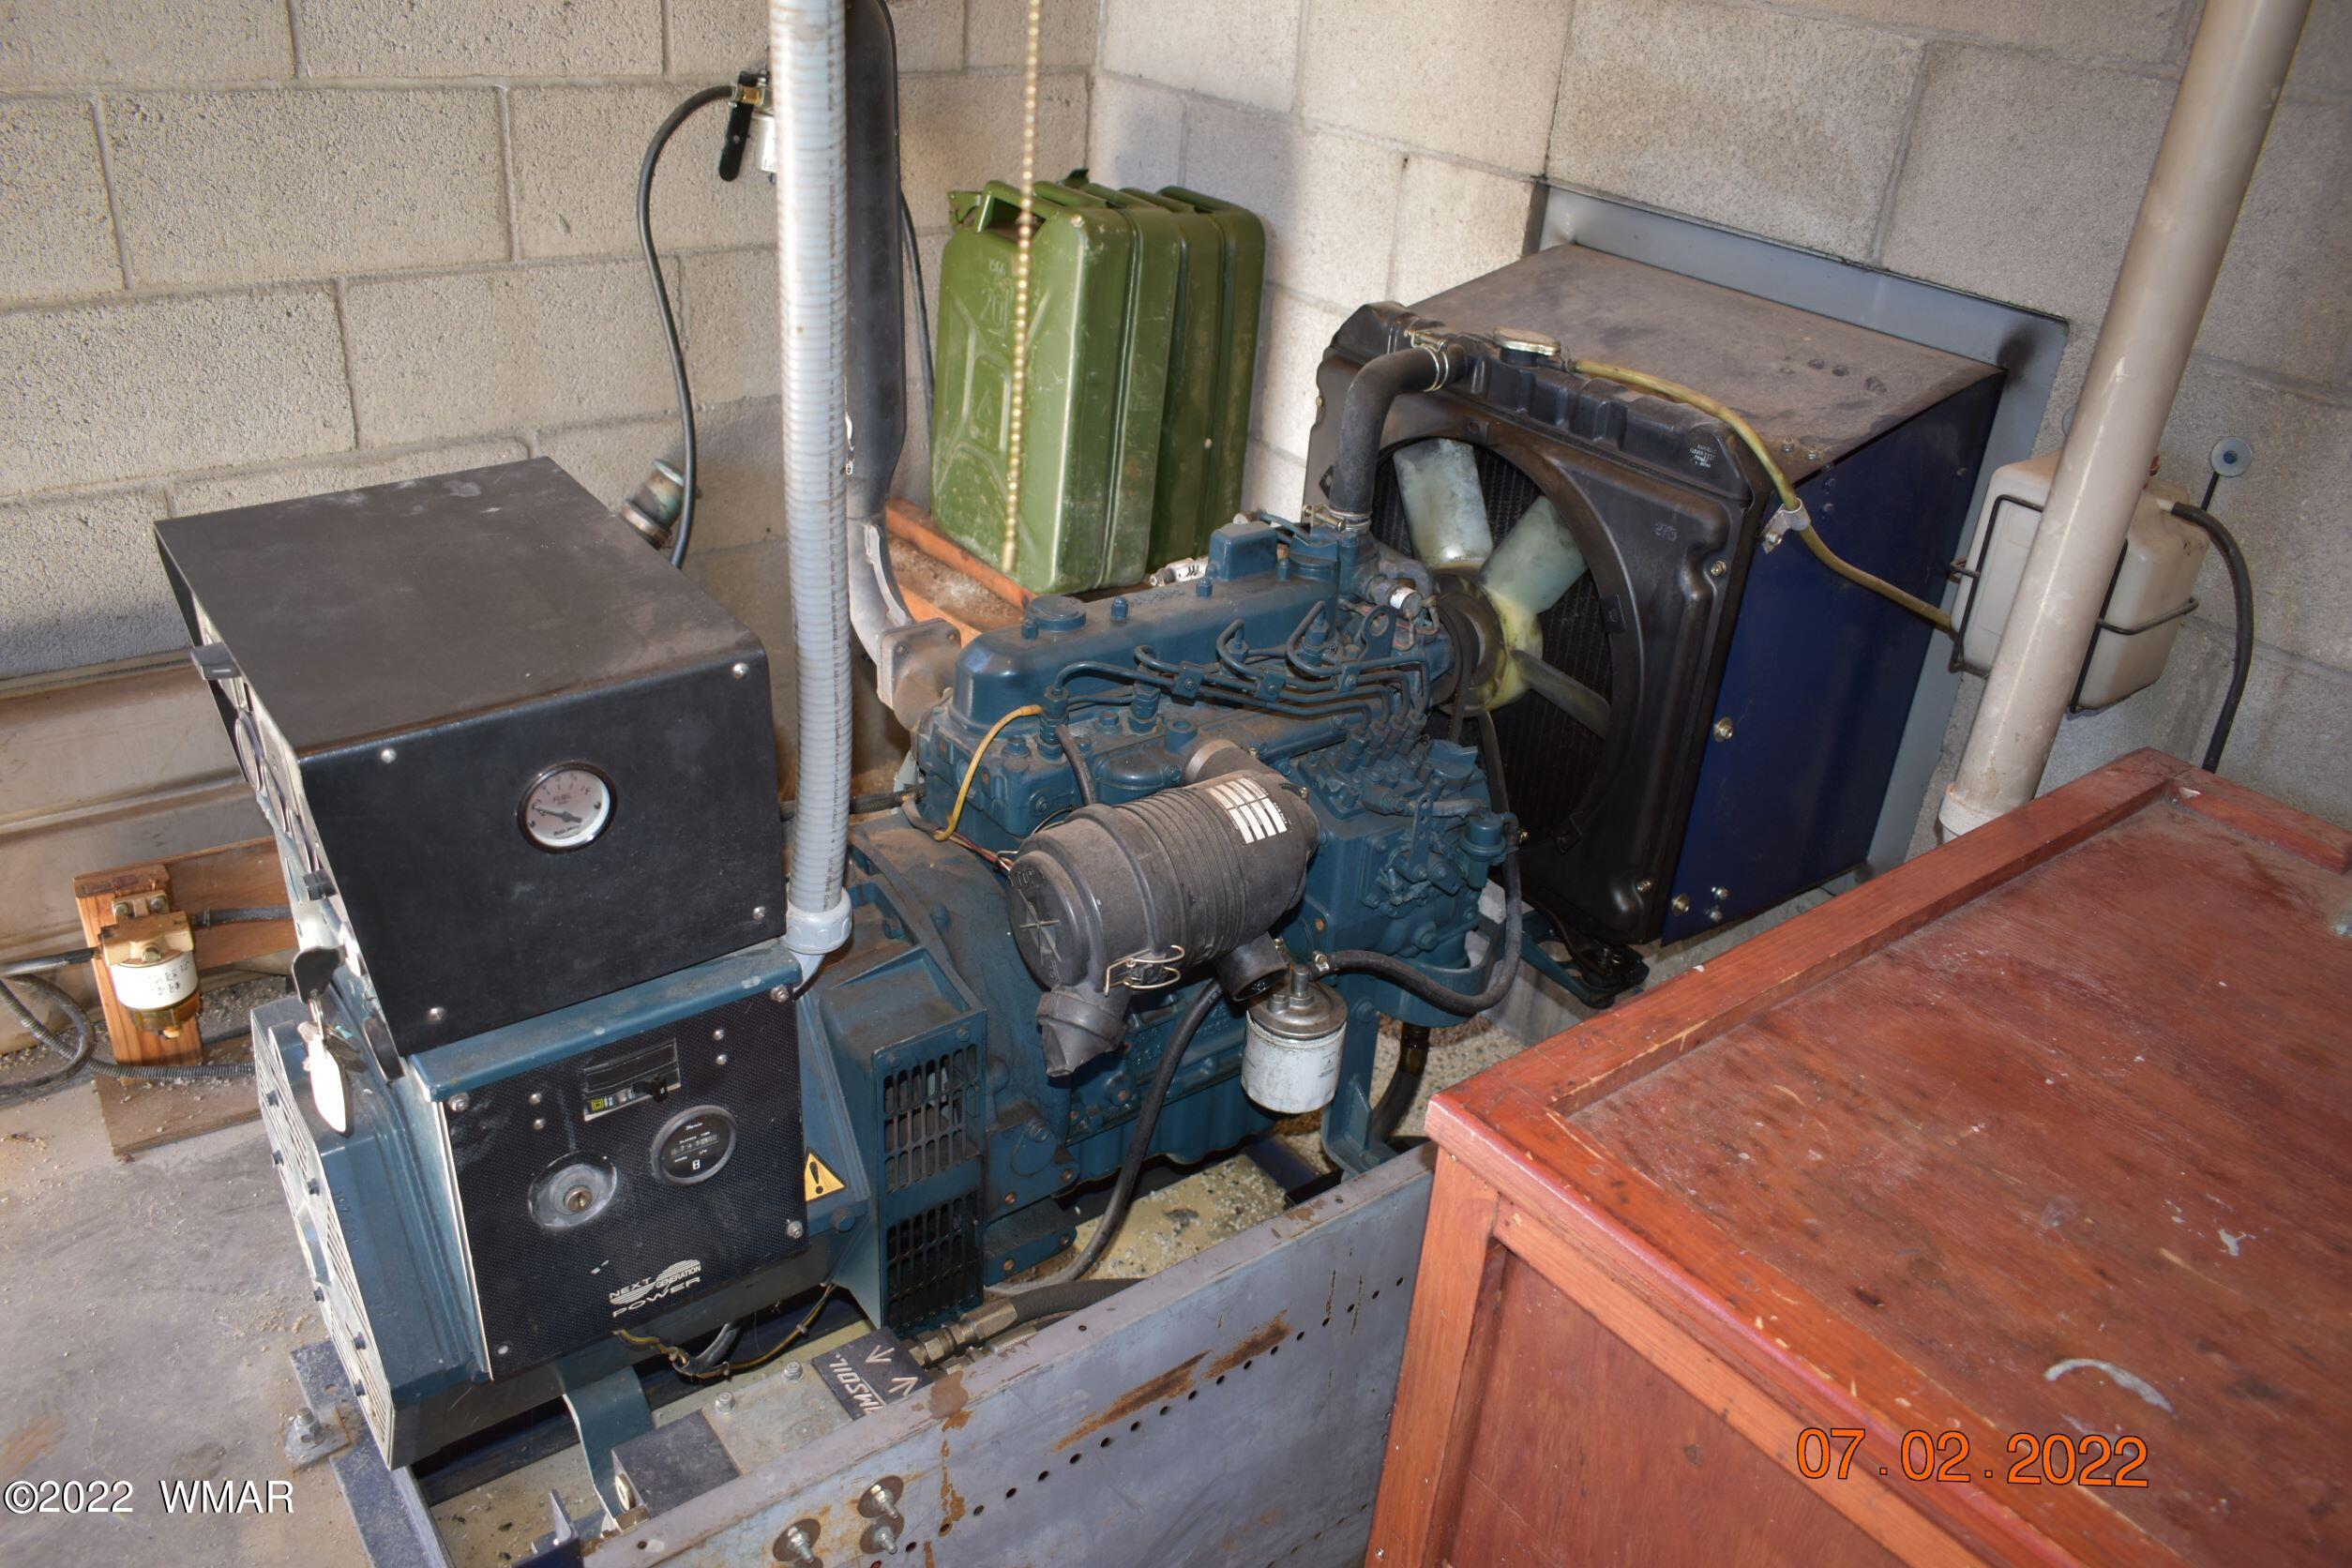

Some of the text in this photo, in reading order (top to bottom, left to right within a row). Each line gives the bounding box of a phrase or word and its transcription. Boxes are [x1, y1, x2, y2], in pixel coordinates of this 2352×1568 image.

[609, 1264, 701, 1300] NEXT GENERATION
[612, 1276, 701, 1318] POWER
